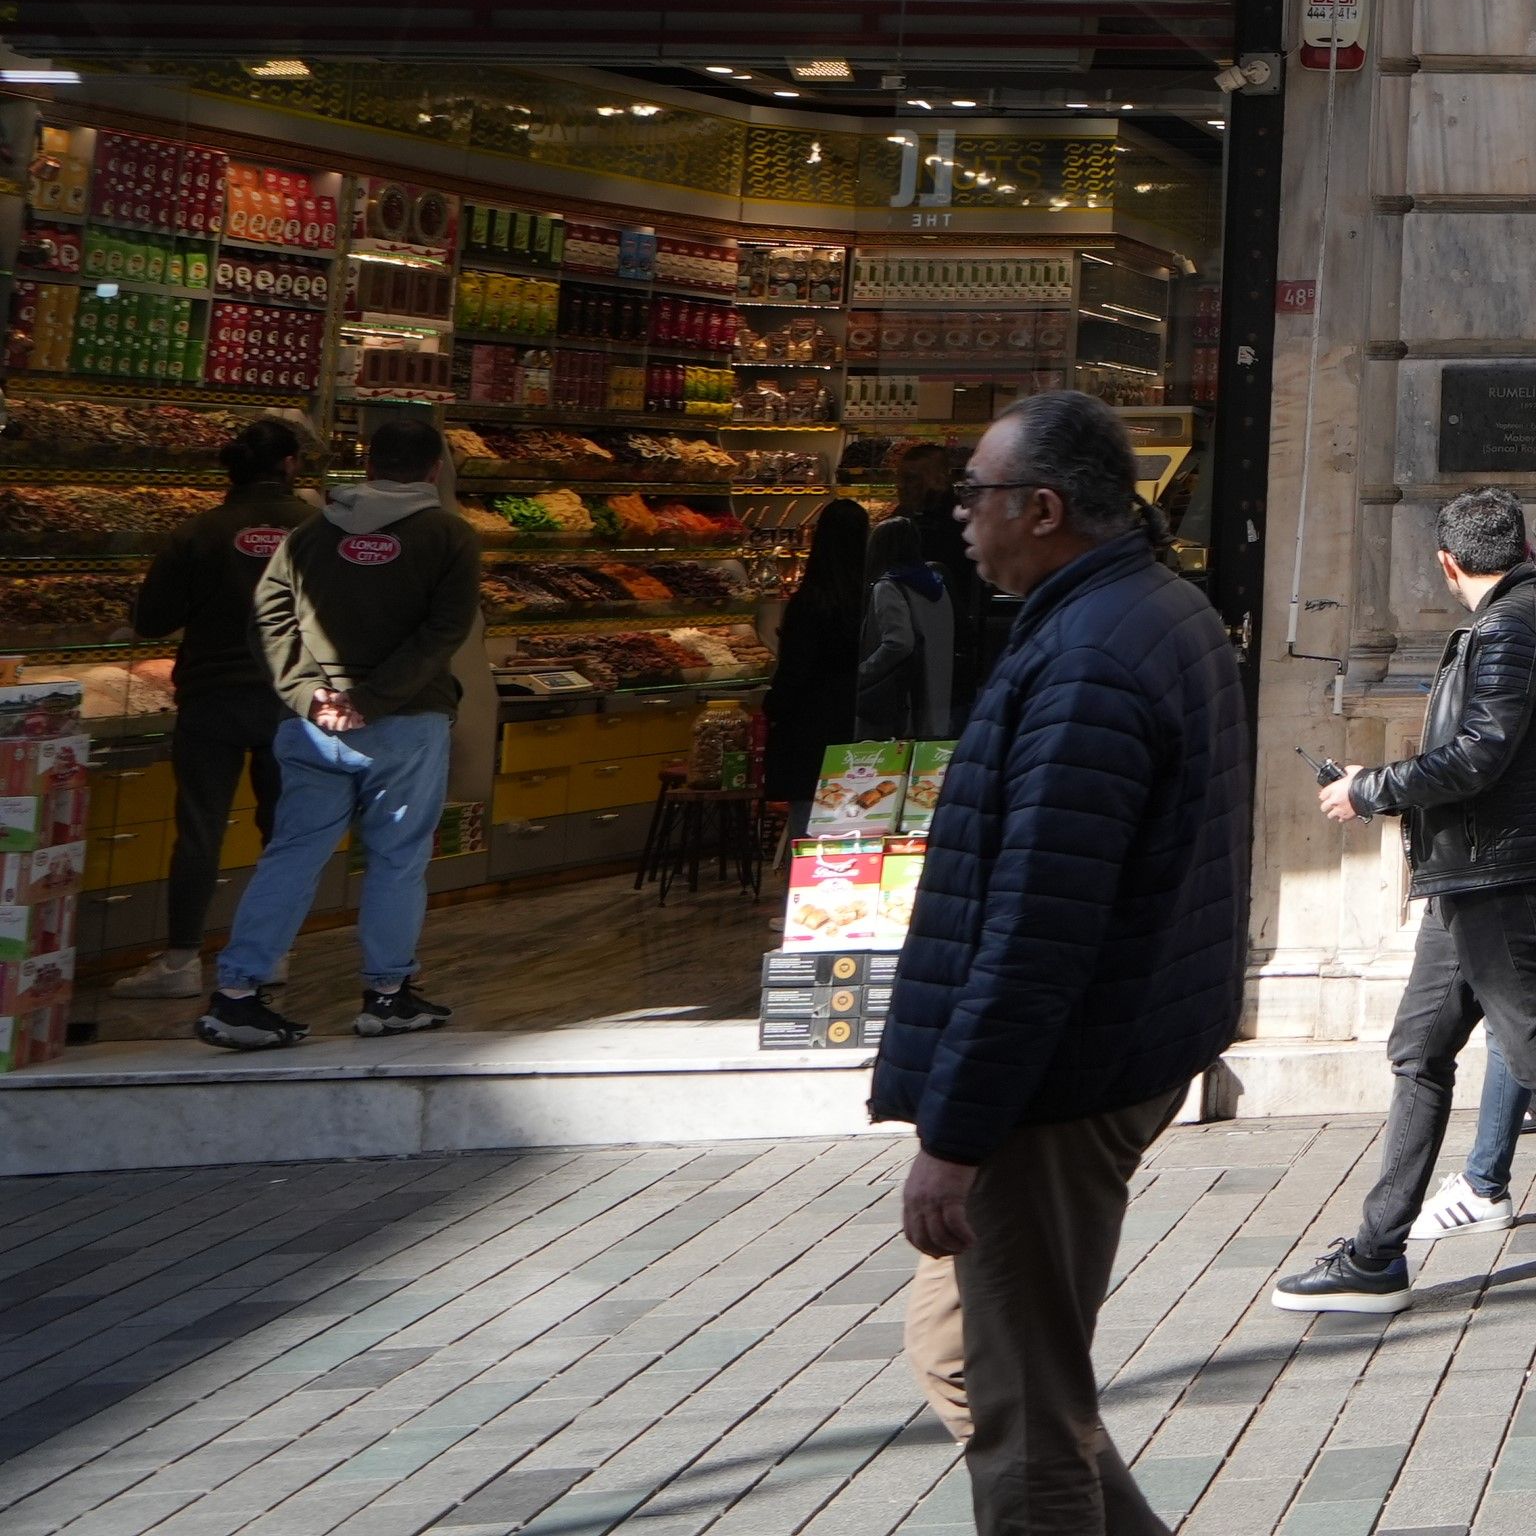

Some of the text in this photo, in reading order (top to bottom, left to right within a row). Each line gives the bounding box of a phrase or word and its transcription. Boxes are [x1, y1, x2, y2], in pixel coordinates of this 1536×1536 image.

[1488, 386, 1536, 398] RUMELİ
[350, 540, 394, 552] LOKUM
[356, 551, 381, 561] CITY
